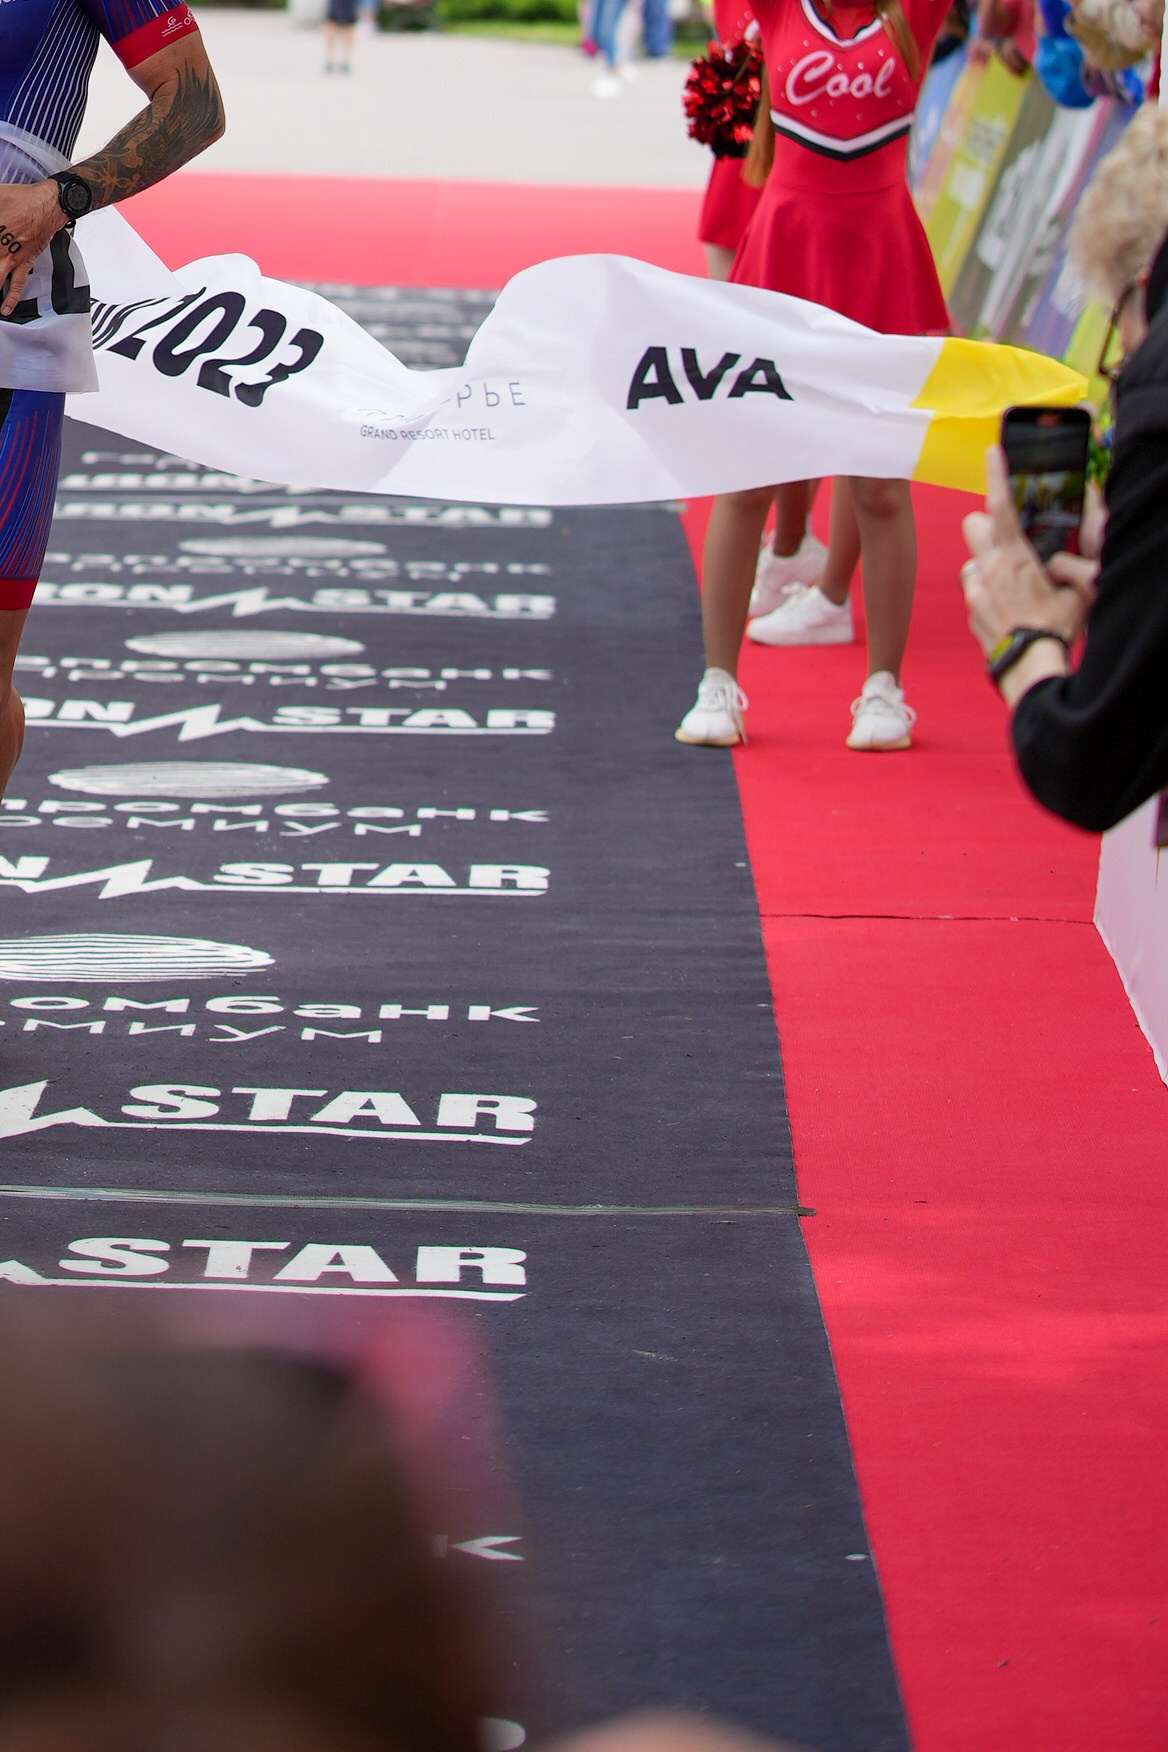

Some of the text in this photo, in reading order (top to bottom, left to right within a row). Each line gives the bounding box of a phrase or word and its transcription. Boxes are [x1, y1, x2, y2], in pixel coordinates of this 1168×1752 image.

[785, 50, 896, 106] Cool
[105, 286, 325, 408] 2023
[626, 346, 795, 410] AVA
[360, 424, 496, 441] GRAND RESORT HOTEL
[272, 705, 556, 729] STAR
[213, 861, 551, 890] STAR
[121, 1083, 537, 1133] STAR
[58, 1236, 528, 1288] STAR
